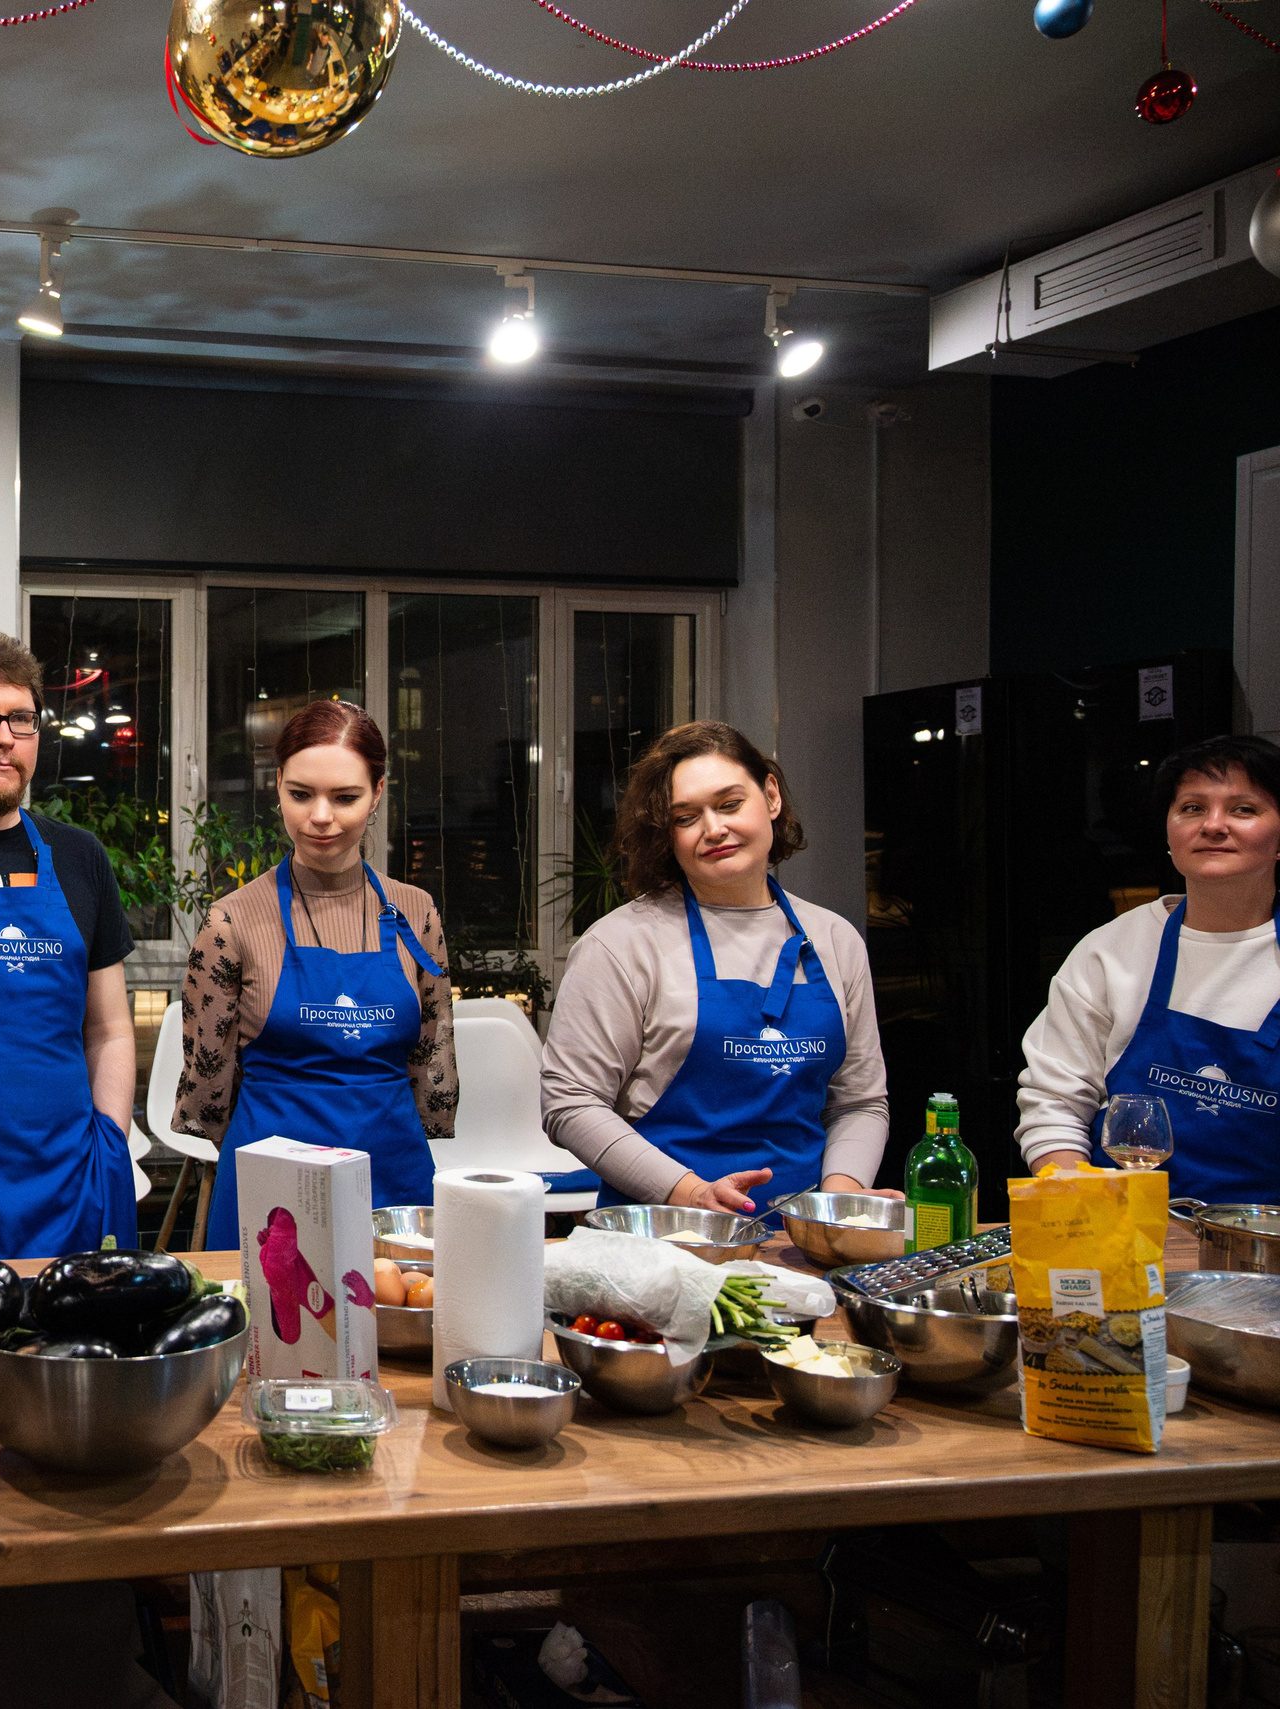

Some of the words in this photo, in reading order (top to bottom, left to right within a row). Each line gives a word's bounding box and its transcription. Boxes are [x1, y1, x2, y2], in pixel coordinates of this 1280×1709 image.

[299, 1006, 395, 1021] ПростоVKUSNO
[723, 1040, 826, 1057] ПростоVKUSNO
[1148, 1067, 1278, 1108] ПростоVKUSNO
